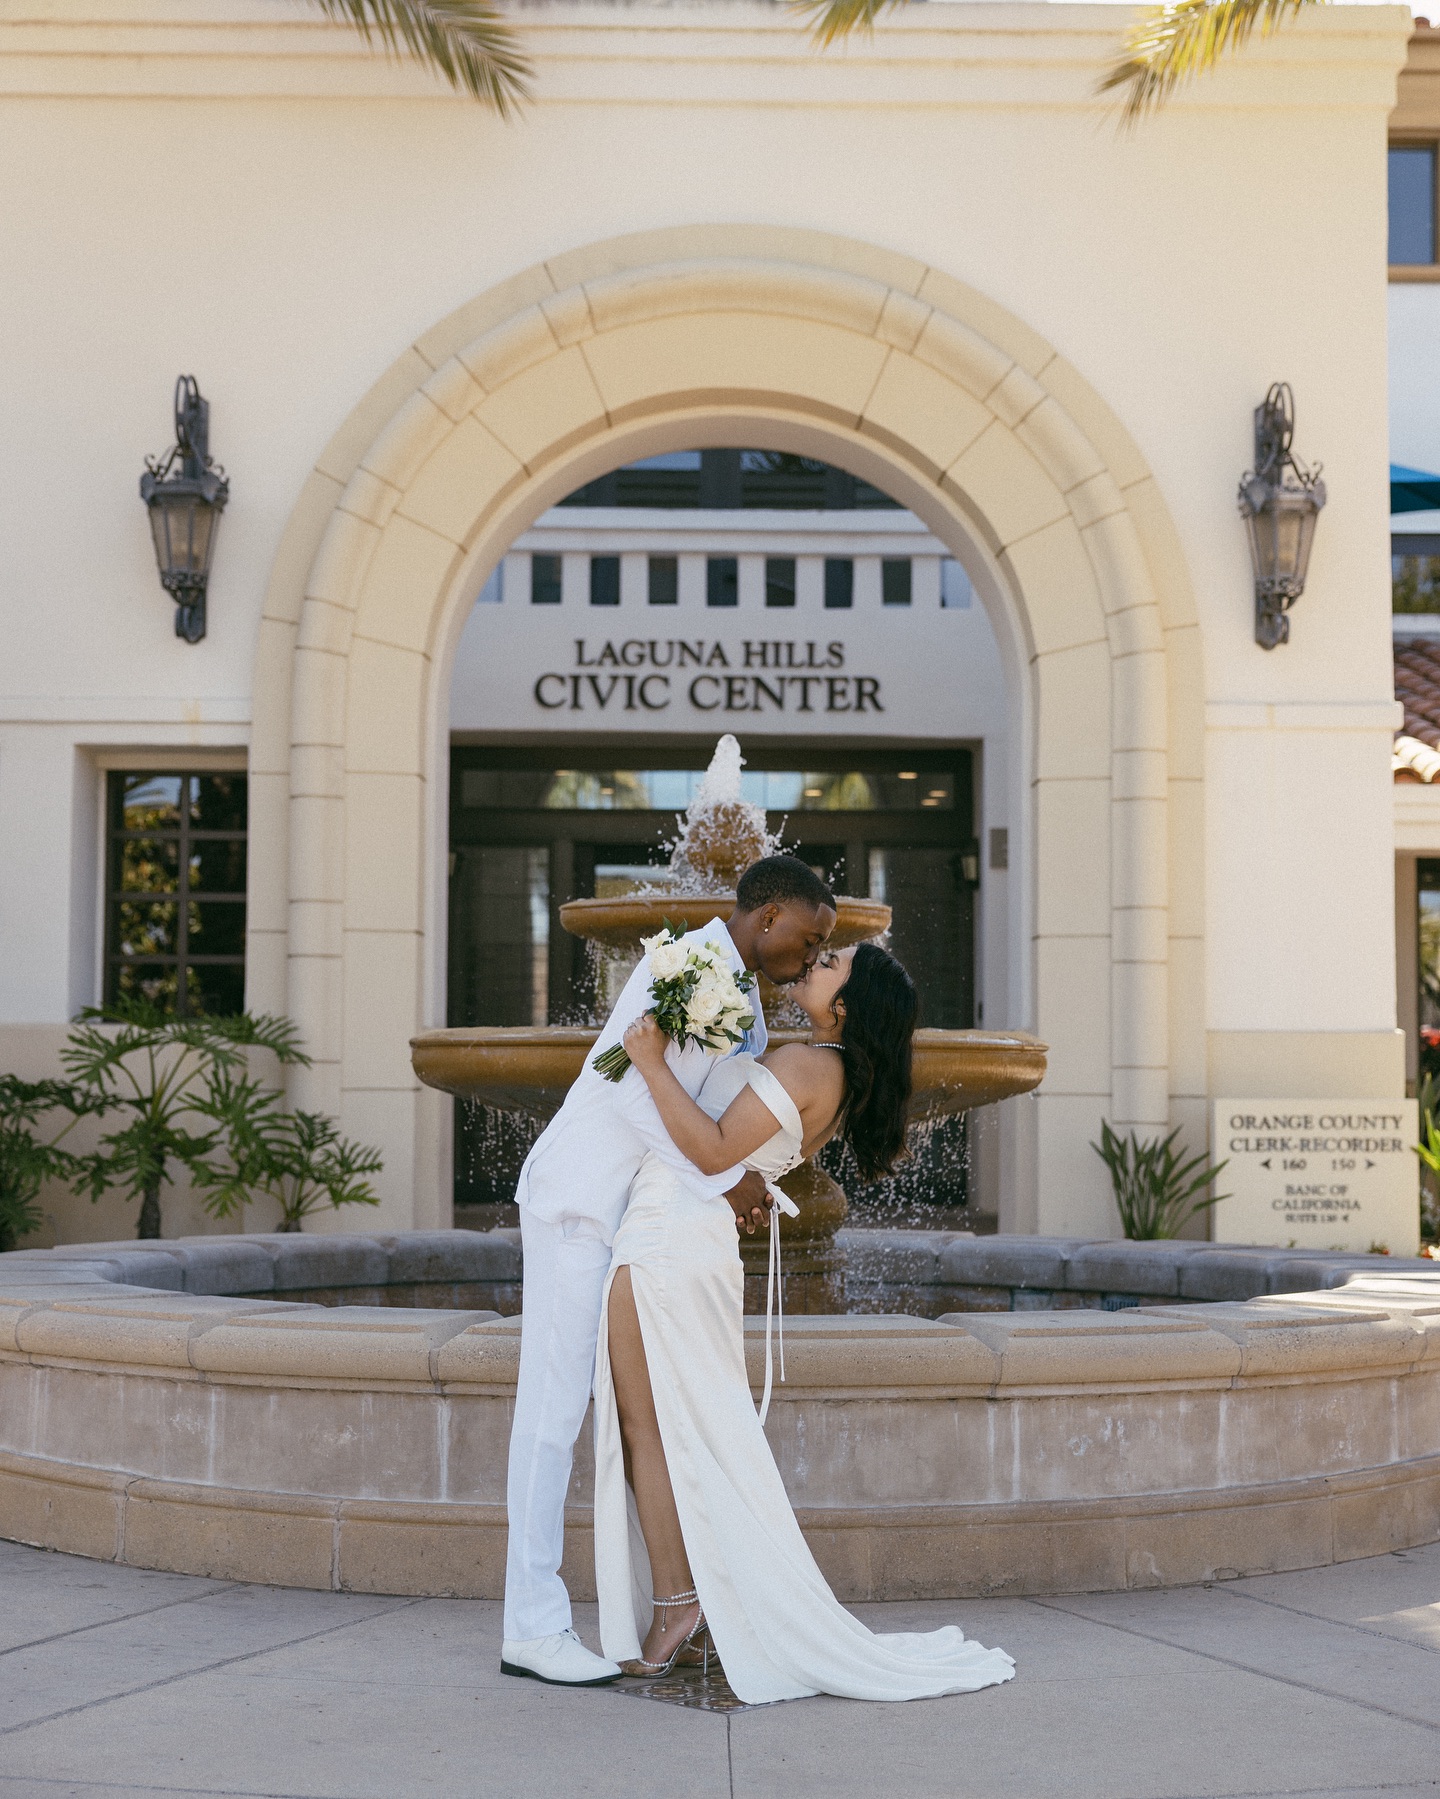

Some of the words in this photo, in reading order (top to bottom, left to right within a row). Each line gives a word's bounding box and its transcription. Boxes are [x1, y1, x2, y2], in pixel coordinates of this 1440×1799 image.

[575, 640, 728, 667] LAGUNA
[743, 641, 844, 668] HILLS
[534, 674, 670, 709] CIVIC
[689, 676, 883, 712] CENTER
[1230, 1115, 1314, 1130] ORANGE
[1319, 1115, 1403, 1131] COUNTY
[1230, 1137, 1403, 1153] CLERK-RECORDER
[1283, 1159, 1307, 1170] 160
[1332, 1159, 1356, 1170] 150
[1272, 1199, 1361, 1211] CALIFORNIA
